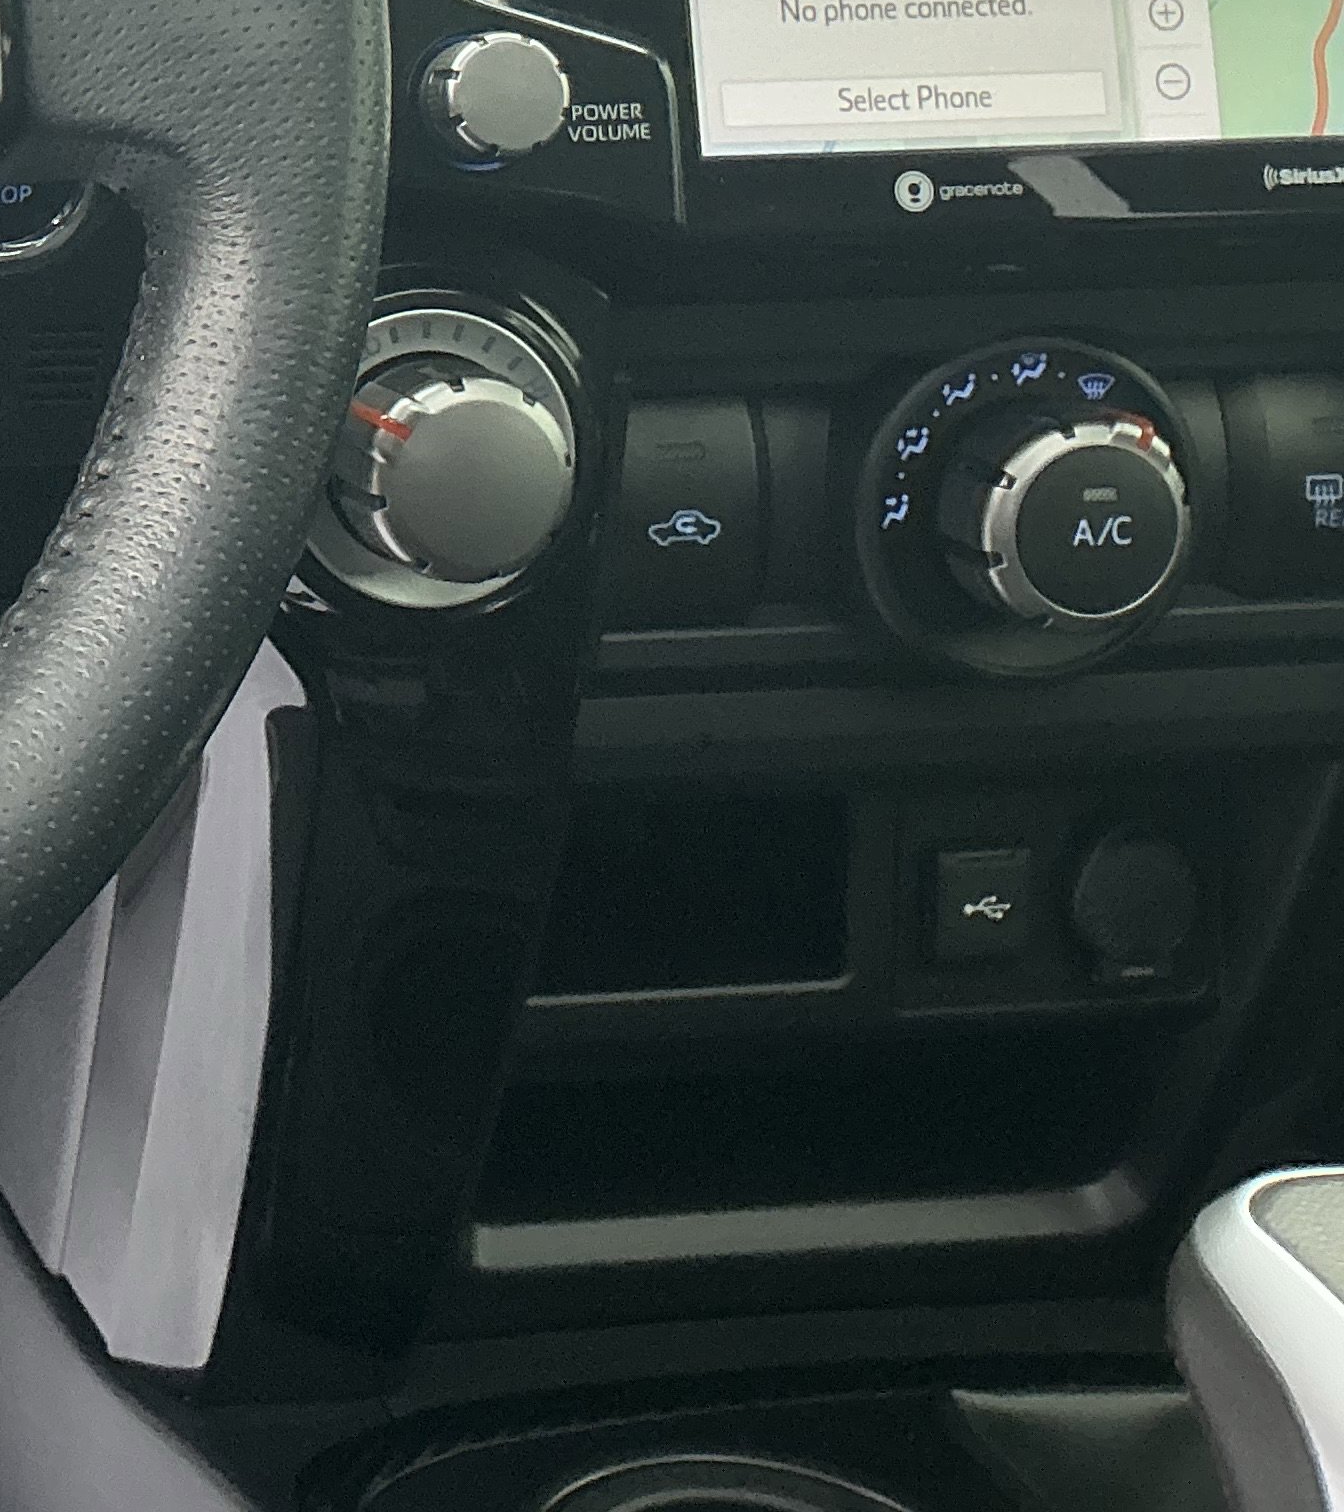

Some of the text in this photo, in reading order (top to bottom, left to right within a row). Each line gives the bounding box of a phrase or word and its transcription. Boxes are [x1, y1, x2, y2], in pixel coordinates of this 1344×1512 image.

[838, 85, 993, 114] Select Phone
[571, 103, 643, 122] POWER
[567, 122, 651, 143] VOLUME
[938, 180, 1024, 201] gracenote
[1315, 508, 1344, 528] RE
[1072, 516, 1133, 548] A/C
